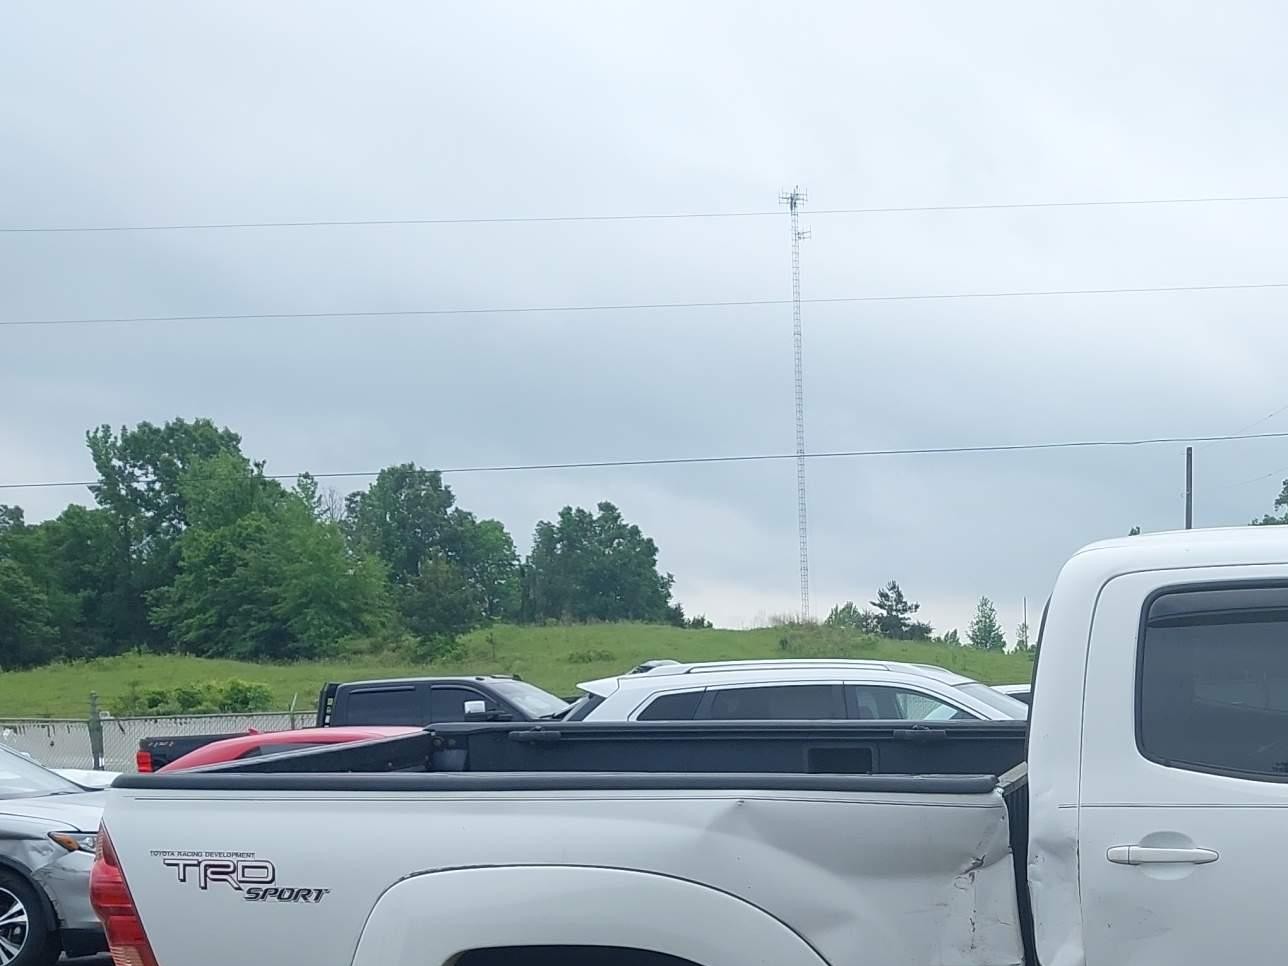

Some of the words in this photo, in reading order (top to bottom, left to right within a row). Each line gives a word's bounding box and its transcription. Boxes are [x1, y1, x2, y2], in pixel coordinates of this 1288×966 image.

[204, 851, 256, 859] DEVELOPMENT
[163, 859, 275, 890] TRD
[244, 887, 330, 903] SPORT
